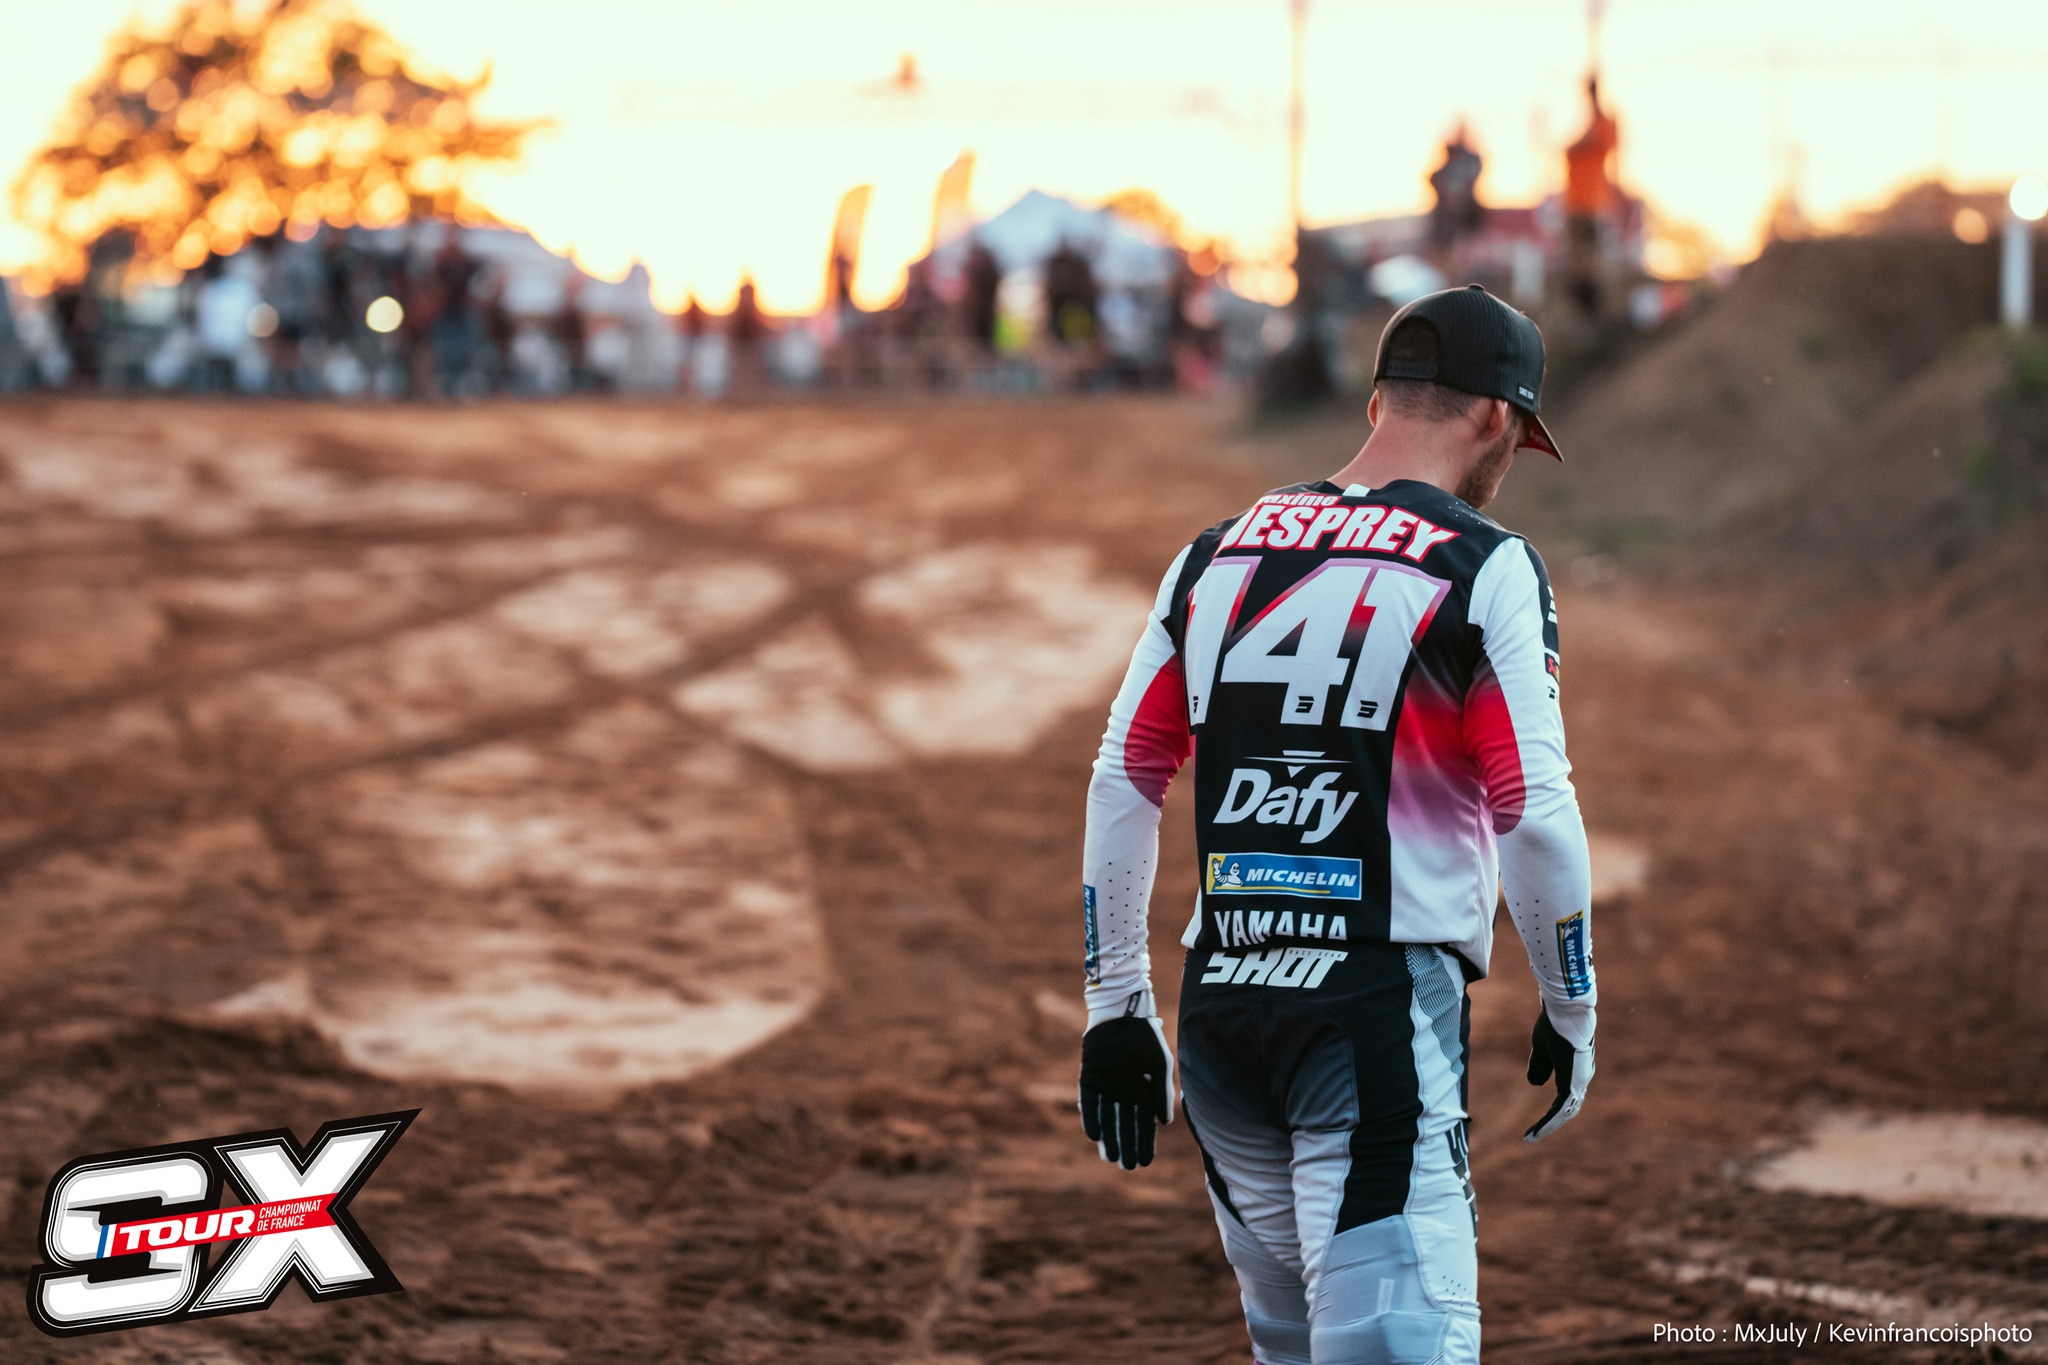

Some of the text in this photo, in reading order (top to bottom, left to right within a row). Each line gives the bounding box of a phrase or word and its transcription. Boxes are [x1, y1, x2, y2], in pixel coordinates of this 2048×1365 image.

[1257, 492, 1341, 507] axime
[1185, 555, 1452, 732] 141
[1212, 768, 1360, 844] Dafy
[1245, 867, 1358, 888] MICHELIN
[1213, 909, 1348, 948] YAMAHA
[1200, 946, 1349, 989] SHOT
